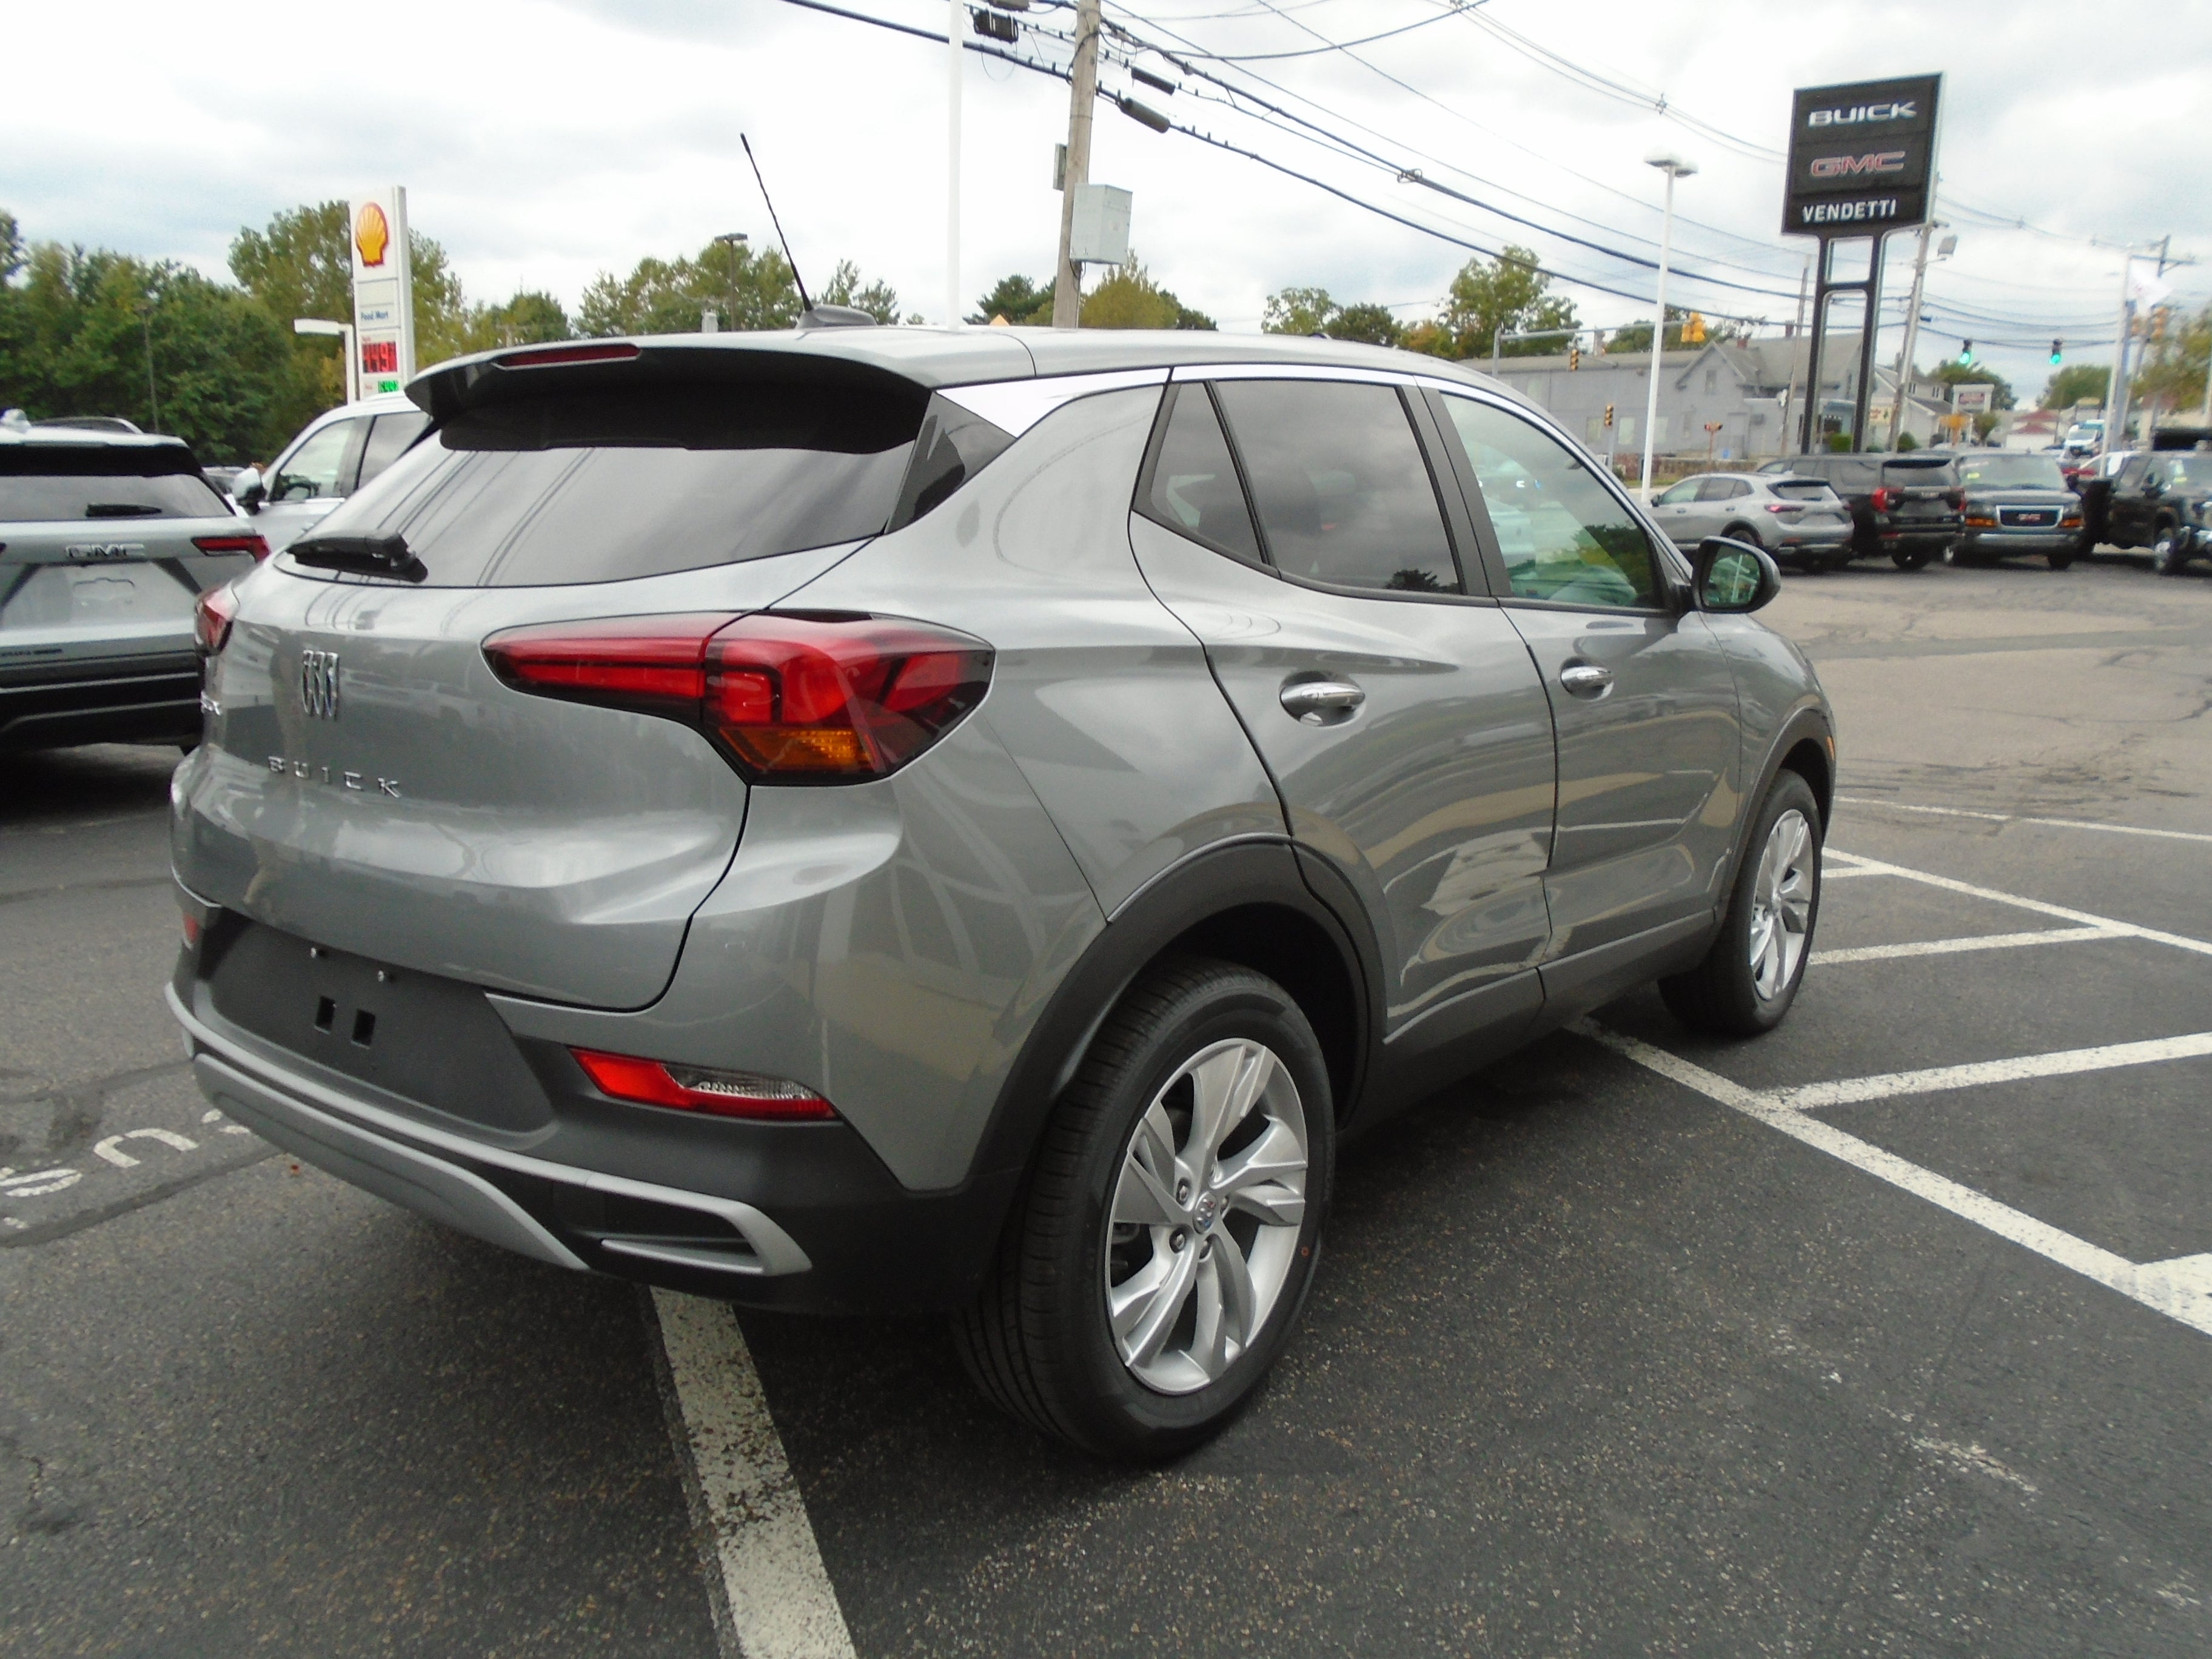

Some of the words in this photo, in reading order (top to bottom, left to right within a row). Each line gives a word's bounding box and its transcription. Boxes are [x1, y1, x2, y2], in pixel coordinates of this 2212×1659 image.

[1808, 101, 1917, 127] BUICK
[1811, 152, 1905, 177] GMC
[1803, 199, 1897, 223] VENDETTI
[65, 543, 146, 559] GMC
[268, 756, 403, 799] BUICK
